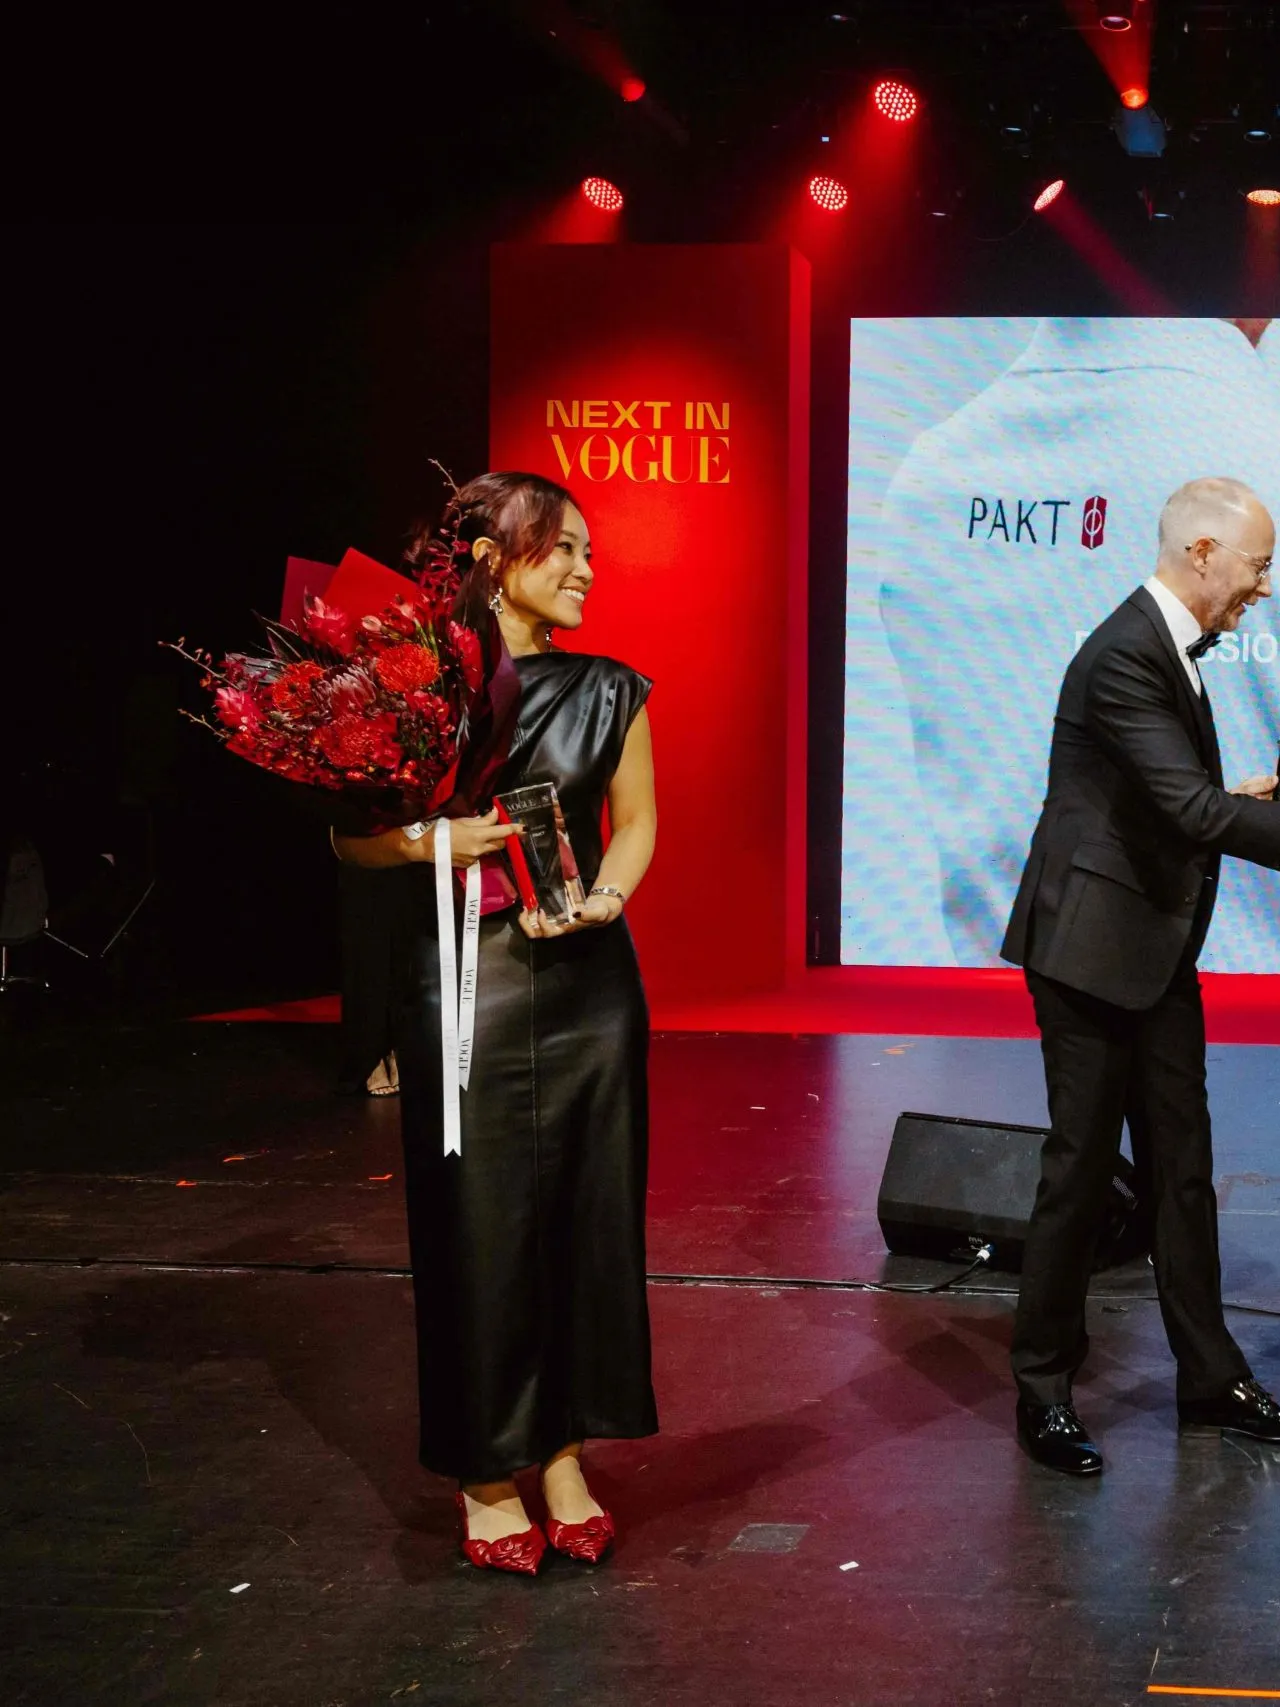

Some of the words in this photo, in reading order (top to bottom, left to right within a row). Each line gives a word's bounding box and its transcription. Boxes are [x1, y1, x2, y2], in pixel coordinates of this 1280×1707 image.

[546, 400, 671, 429] NEXT
[685, 402, 730, 430] IN
[551, 433, 730, 484] VOGUE
[968, 497, 1071, 545] PAKT
